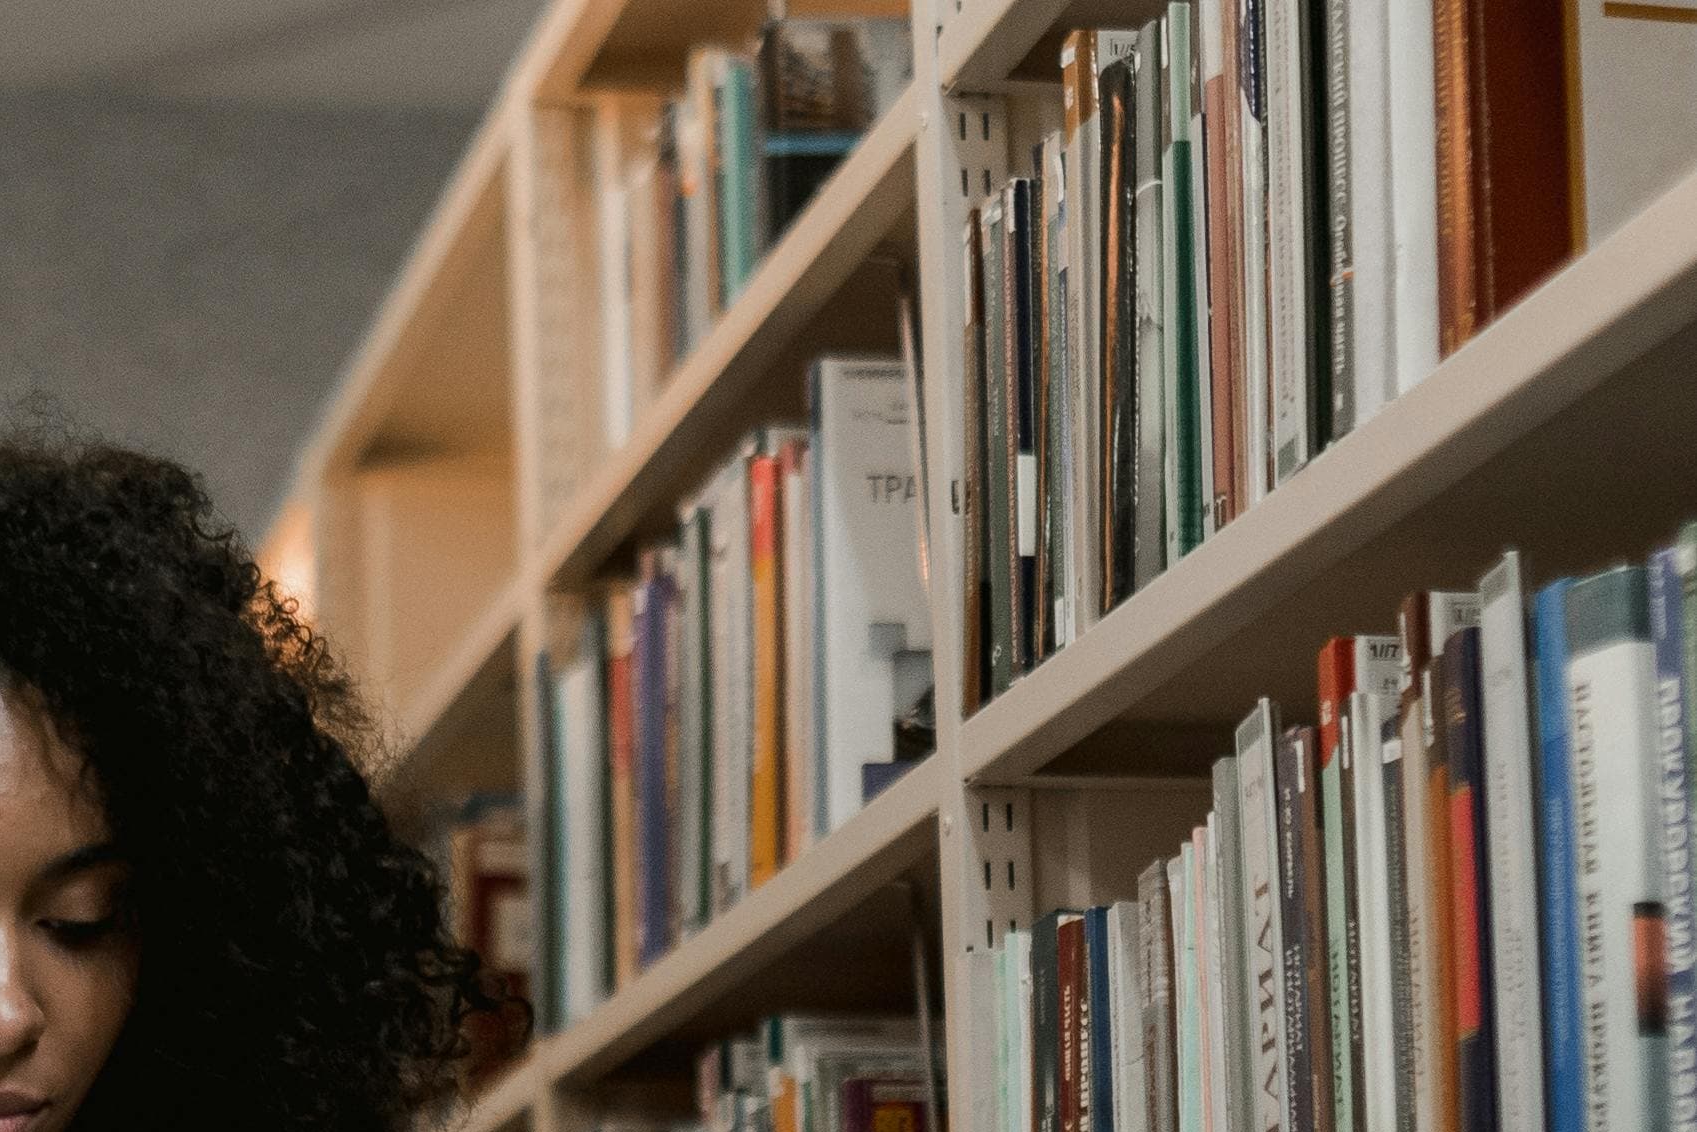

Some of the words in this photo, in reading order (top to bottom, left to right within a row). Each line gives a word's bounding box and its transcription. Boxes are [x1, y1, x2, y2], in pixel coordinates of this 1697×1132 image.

[1575, 683, 1599, 874] НАСТОЛЬНАЯ
[1586, 889, 1603, 986] КНИГА
[1080, 998, 1088, 1107] ПРОЦЕСС
